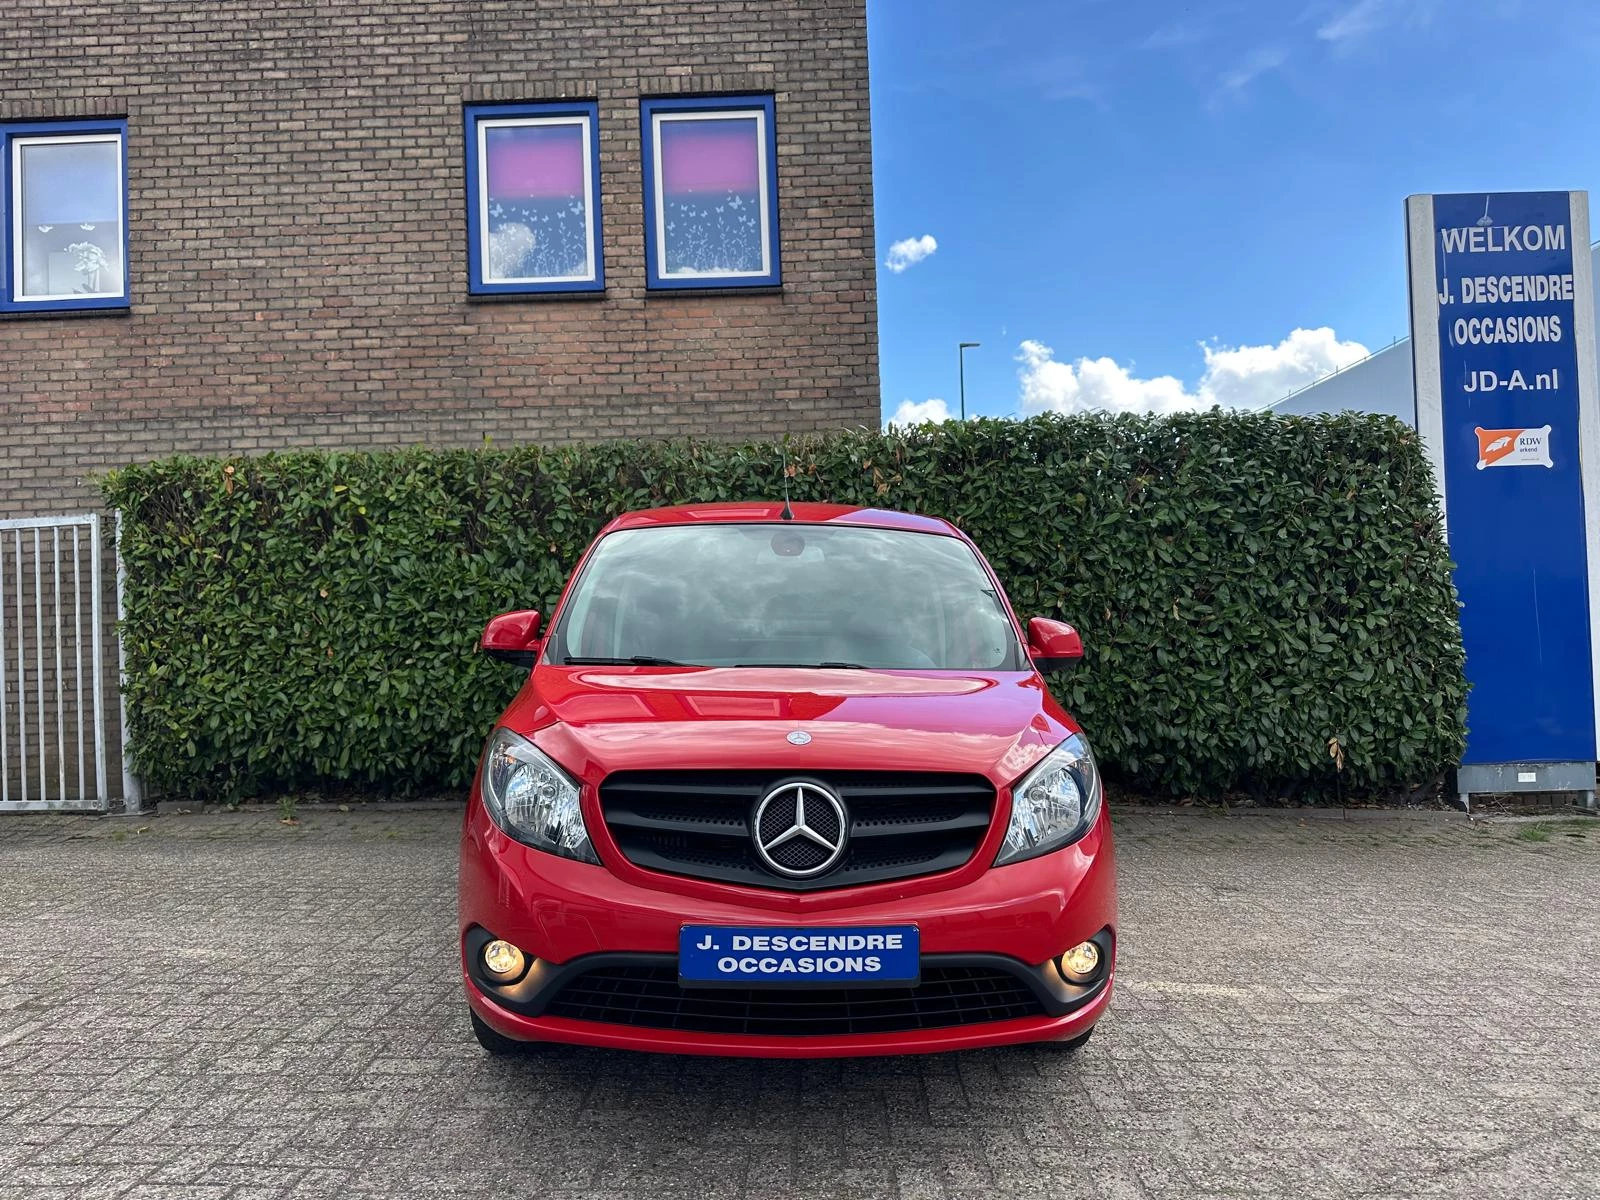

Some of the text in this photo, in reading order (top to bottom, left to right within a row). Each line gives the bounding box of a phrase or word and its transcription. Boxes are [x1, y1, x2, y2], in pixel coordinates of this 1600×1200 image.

[1441, 225, 1565, 253] WELKOM
[1438, 274, 1575, 305] J. DESCENDRE
[1454, 315, 1562, 345] OCCASIONS
[1463, 369, 1559, 392] JD-A.nl
[1520, 437, 1541, 446] RDW
[696, 934, 903, 951] J. DESCENDRE
[717, 956, 882, 973] OCCASIONS
